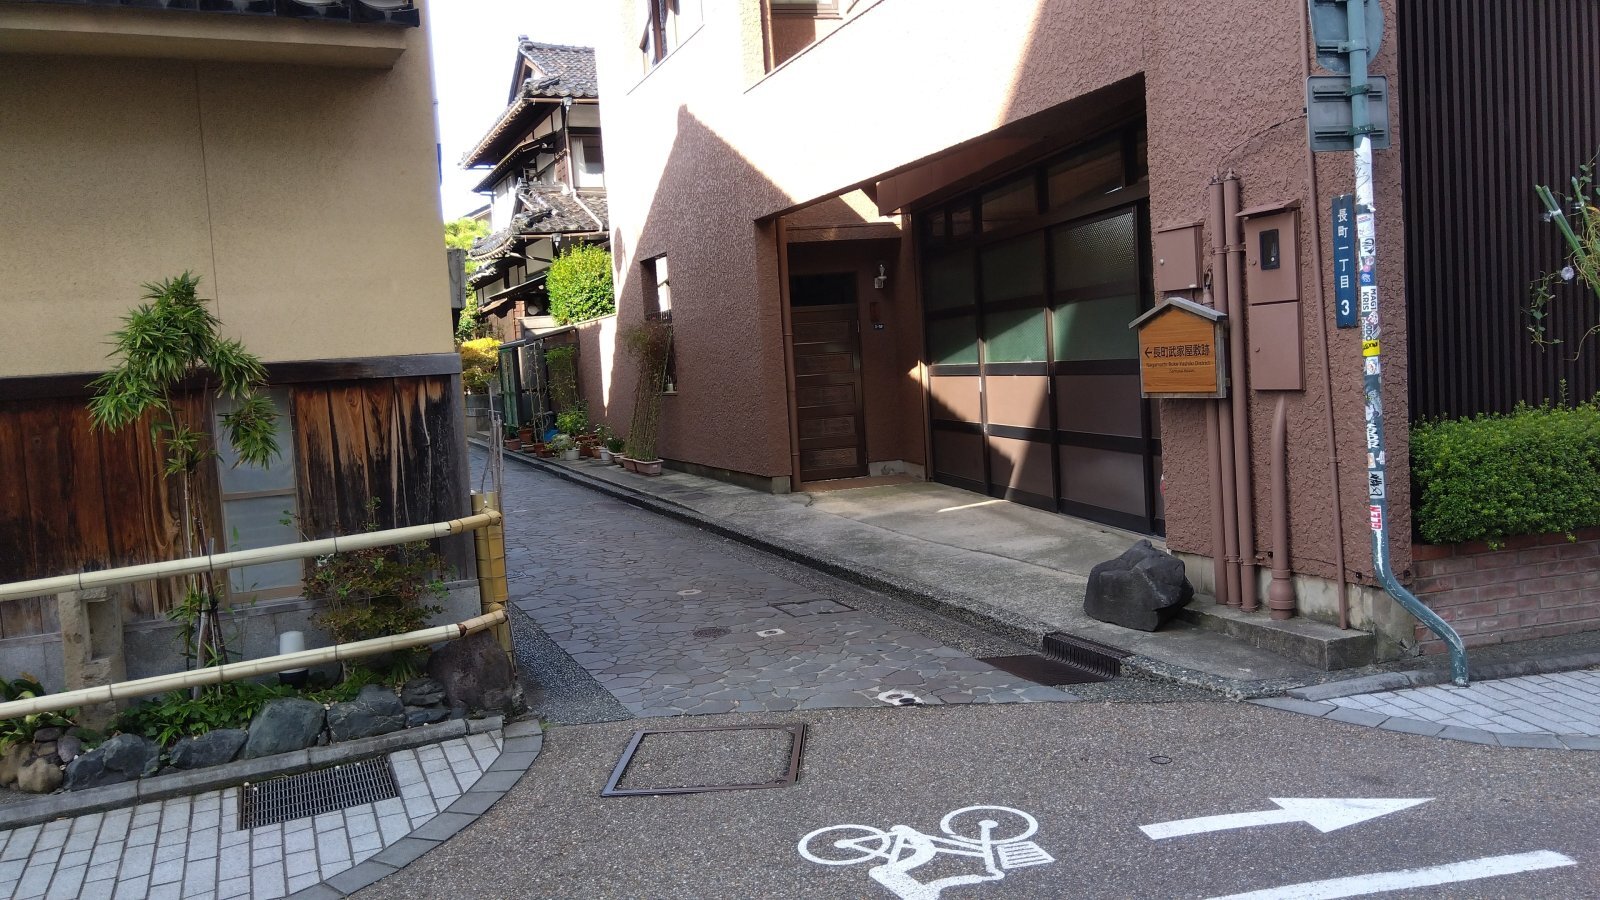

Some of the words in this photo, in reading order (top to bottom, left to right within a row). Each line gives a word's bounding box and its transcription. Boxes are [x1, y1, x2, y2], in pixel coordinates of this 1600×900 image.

[1337, 208, 1349, 288] 長町一丁目
[1340, 299, 1350, 316] 3
[1362, 291, 1370, 311] KRIS
[1153, 343, 1210, 358] 長町武家屋敷跡
